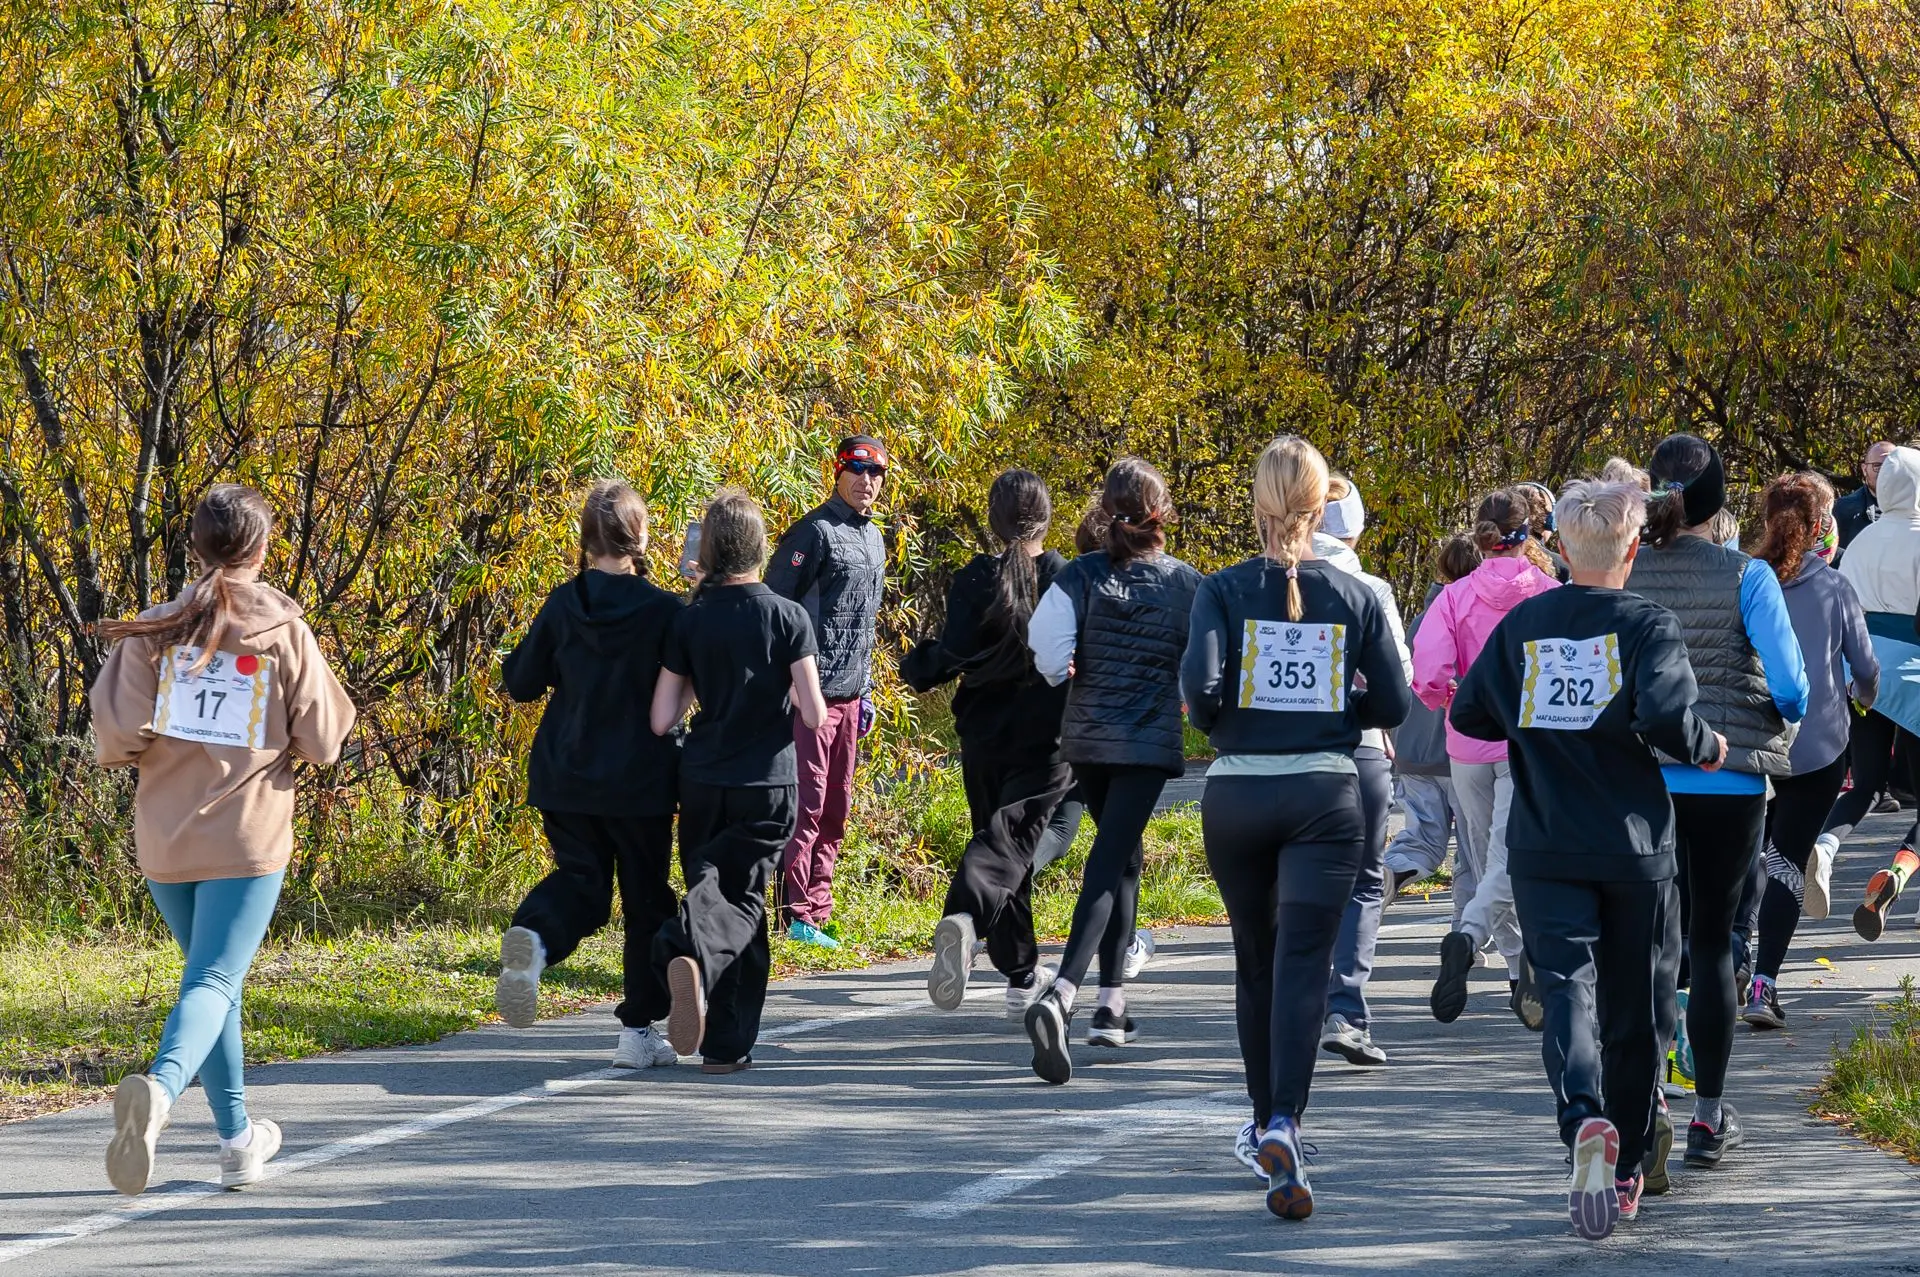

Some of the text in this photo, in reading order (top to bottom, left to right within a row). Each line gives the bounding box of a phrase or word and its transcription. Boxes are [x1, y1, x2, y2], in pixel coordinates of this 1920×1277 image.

[1268, 660, 1316, 689] 353
[195, 689, 227, 720] 17
[1255, 695, 1324, 705] МАГАДАНСКАЯ ОБЛАСТЬ
[1548, 677, 1594, 707] 262
[1536, 714, 1579, 723] МАГАДАНСКАЯ
